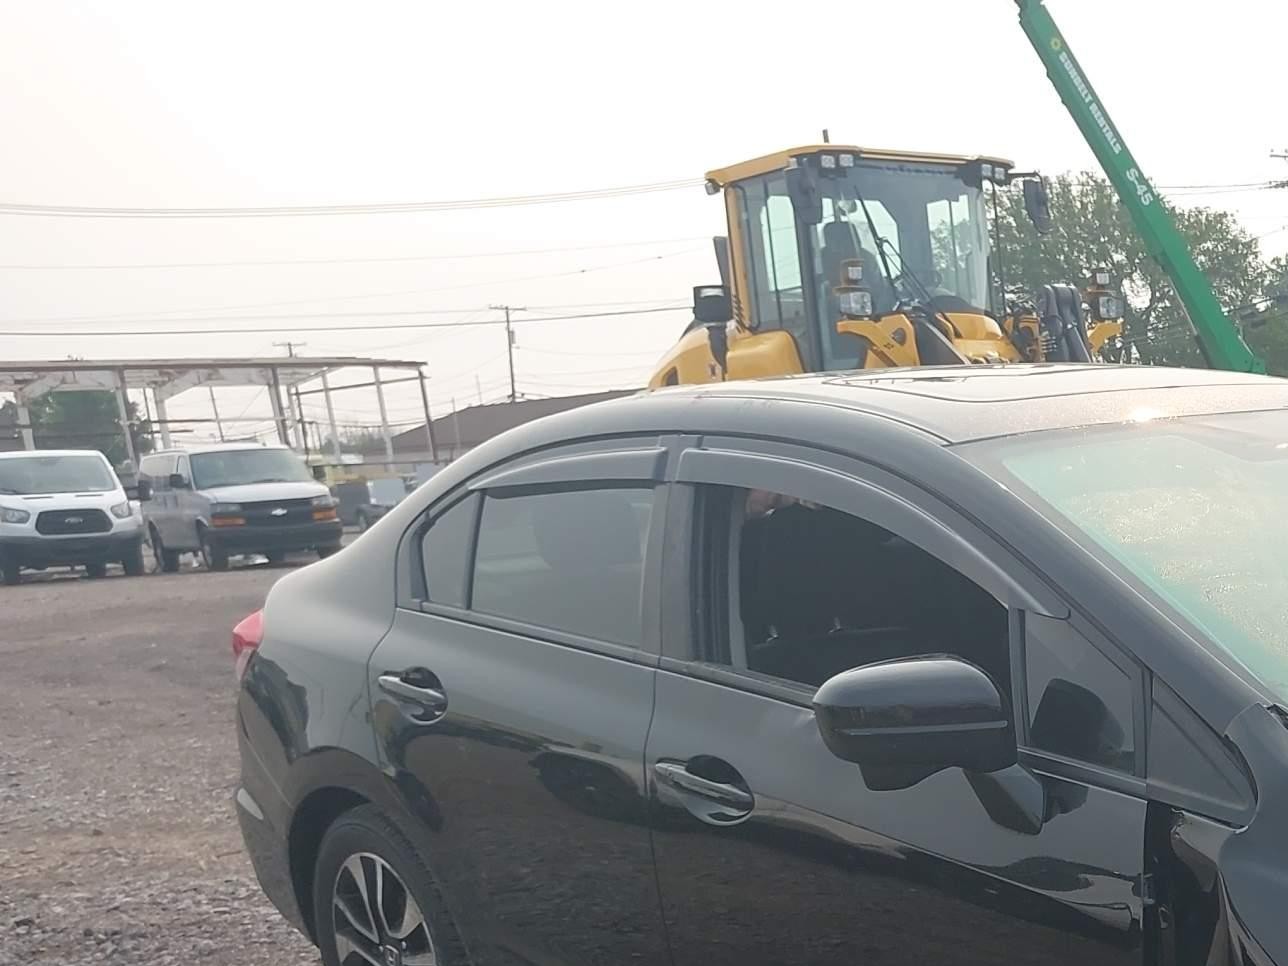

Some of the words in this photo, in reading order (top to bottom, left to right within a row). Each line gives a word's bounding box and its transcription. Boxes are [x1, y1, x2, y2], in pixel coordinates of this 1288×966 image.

[1058, 51, 1092, 103] SUNBELT
[1089, 102, 1122, 154] RENTALS
[1125, 167, 1154, 207] S-45
